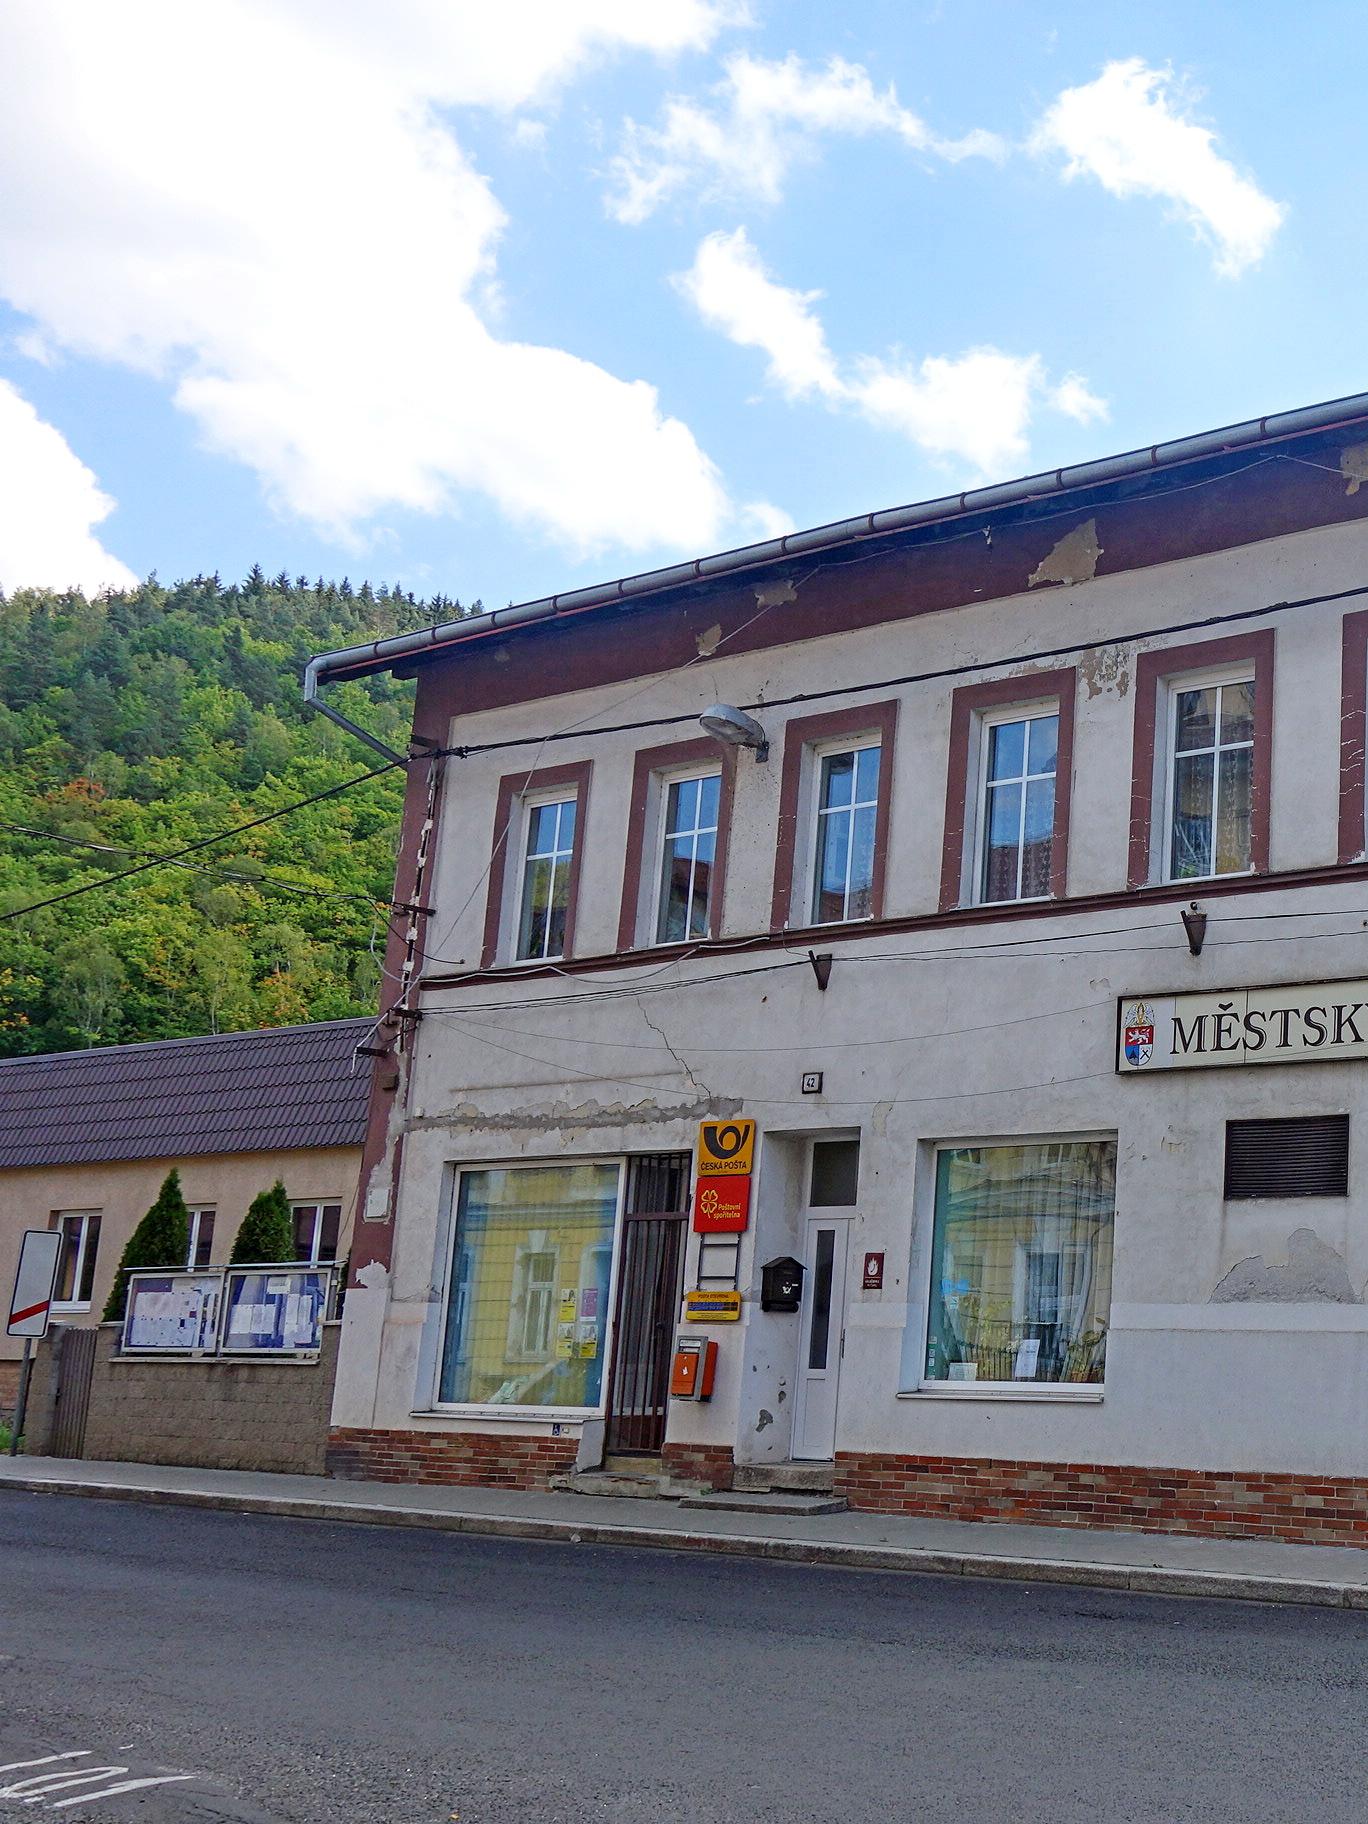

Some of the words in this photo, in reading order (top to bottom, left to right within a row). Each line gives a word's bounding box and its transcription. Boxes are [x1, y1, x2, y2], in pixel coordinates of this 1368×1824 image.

[806, 1078, 815, 1088] 42
[701, 1161, 722, 1170] ČESKÁ
[724, 1160, 746, 1169] POŠTA
